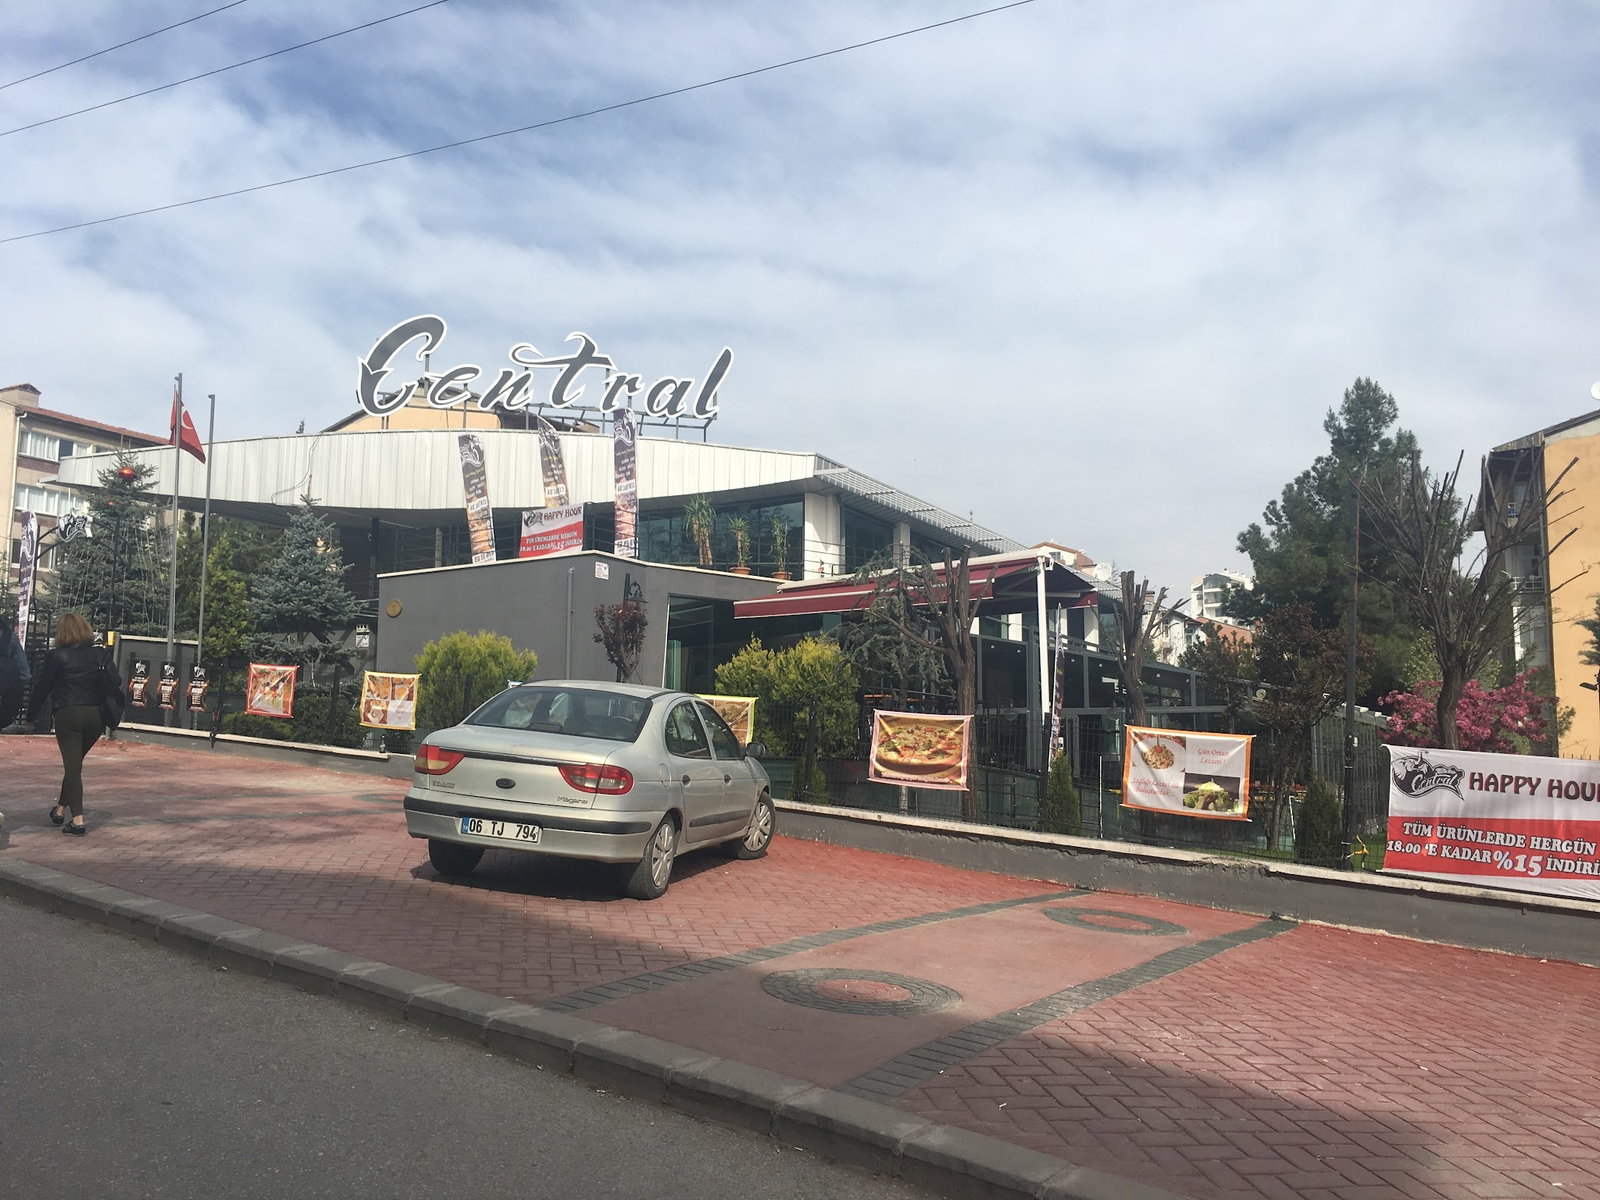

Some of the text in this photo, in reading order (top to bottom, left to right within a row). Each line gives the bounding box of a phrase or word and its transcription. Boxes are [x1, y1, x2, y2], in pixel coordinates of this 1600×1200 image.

[357, 313, 735, 419] Central
[1412, 772, 1458, 792] Central
[1469, 771, 1600, 802] HAPPY HOU
[469, 819, 537, 840] 06 TJ 794
[1403, 821, 1597, 856] TÜM ÜRÜNLERDE HERGÜN
[1387, 840, 1421, 854] 18.00
[1441, 844, 1492, 864] KADAR
[1493, 850, 1544, 877] %15
